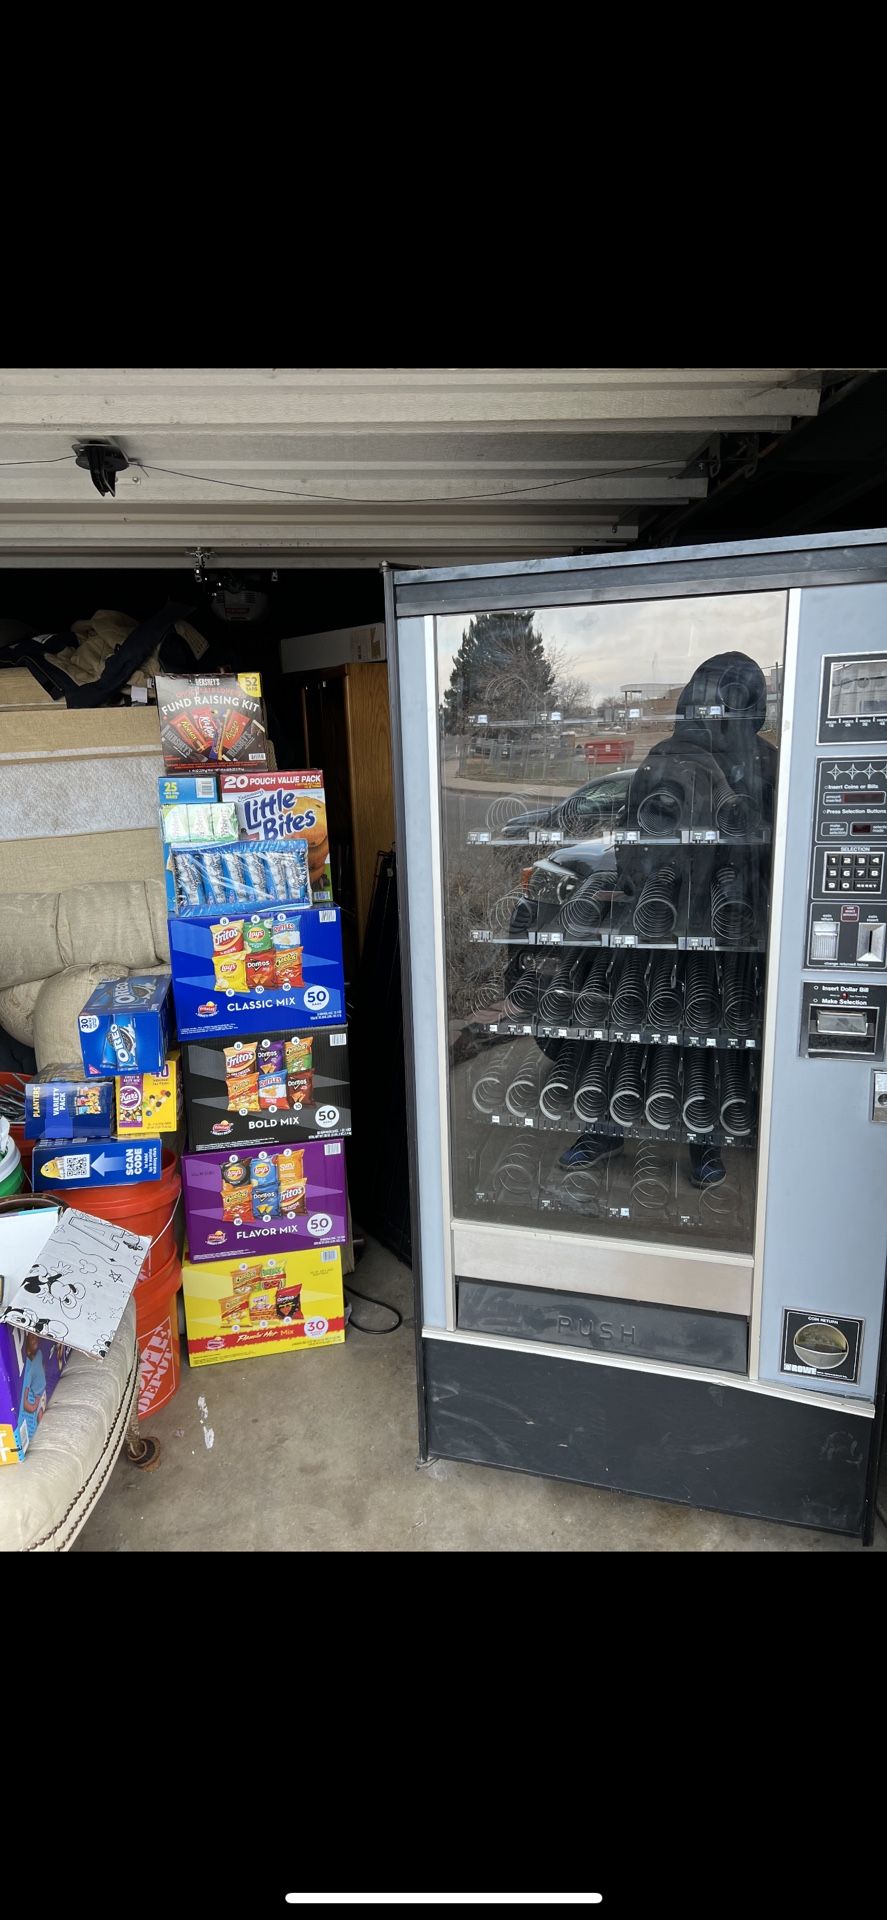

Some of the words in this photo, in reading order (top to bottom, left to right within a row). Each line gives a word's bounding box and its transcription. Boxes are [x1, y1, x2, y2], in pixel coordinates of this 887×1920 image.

[244, 678, 258, 687] 52
[161, 698, 192, 715] FUND
[194, 695, 239, 707] RAISING
[241, 699, 260, 713] KIT
[164, 782, 178, 792] 25
[223, 775, 249, 789] 20
[249, 778, 276, 786] POUCH
[277, 776, 301, 785] VALUE
[301, 775, 321, 783] PACK
[243, 789, 296, 831] Little
[262, 809, 317, 840] Bites
[115, 981, 136, 1004] OREO
[307, 991, 327, 1002] 50
[226, 999, 274, 1012] CLASSIC
[275, 996, 296, 1006] MIX
[81, 1018, 89, 1029] 30
[110, 1023, 130, 1063] OREO
[226, 1051, 253, 1068] Fritos
[32, 1086, 41, 1118] PLANTERS
[52, 1087, 60, 1116] VARIETY
[120, 1093, 138, 1104] Kar's
[248, 1119, 278, 1130] BOLD
[280, 1117, 300, 1126] MIX
[318, 1110, 336, 1121] 50
[126, 1148, 134, 1176] SCAN
[134, 1148, 142, 1175] CODE
[310, 1218, 329, 1230] 50
[236, 1227, 277, 1240] FLAVOR
[279, 1225, 298, 1234] MIX
[307, 1320, 325, 1332] 30
[557, 1315, 636, 1345] PUSH
